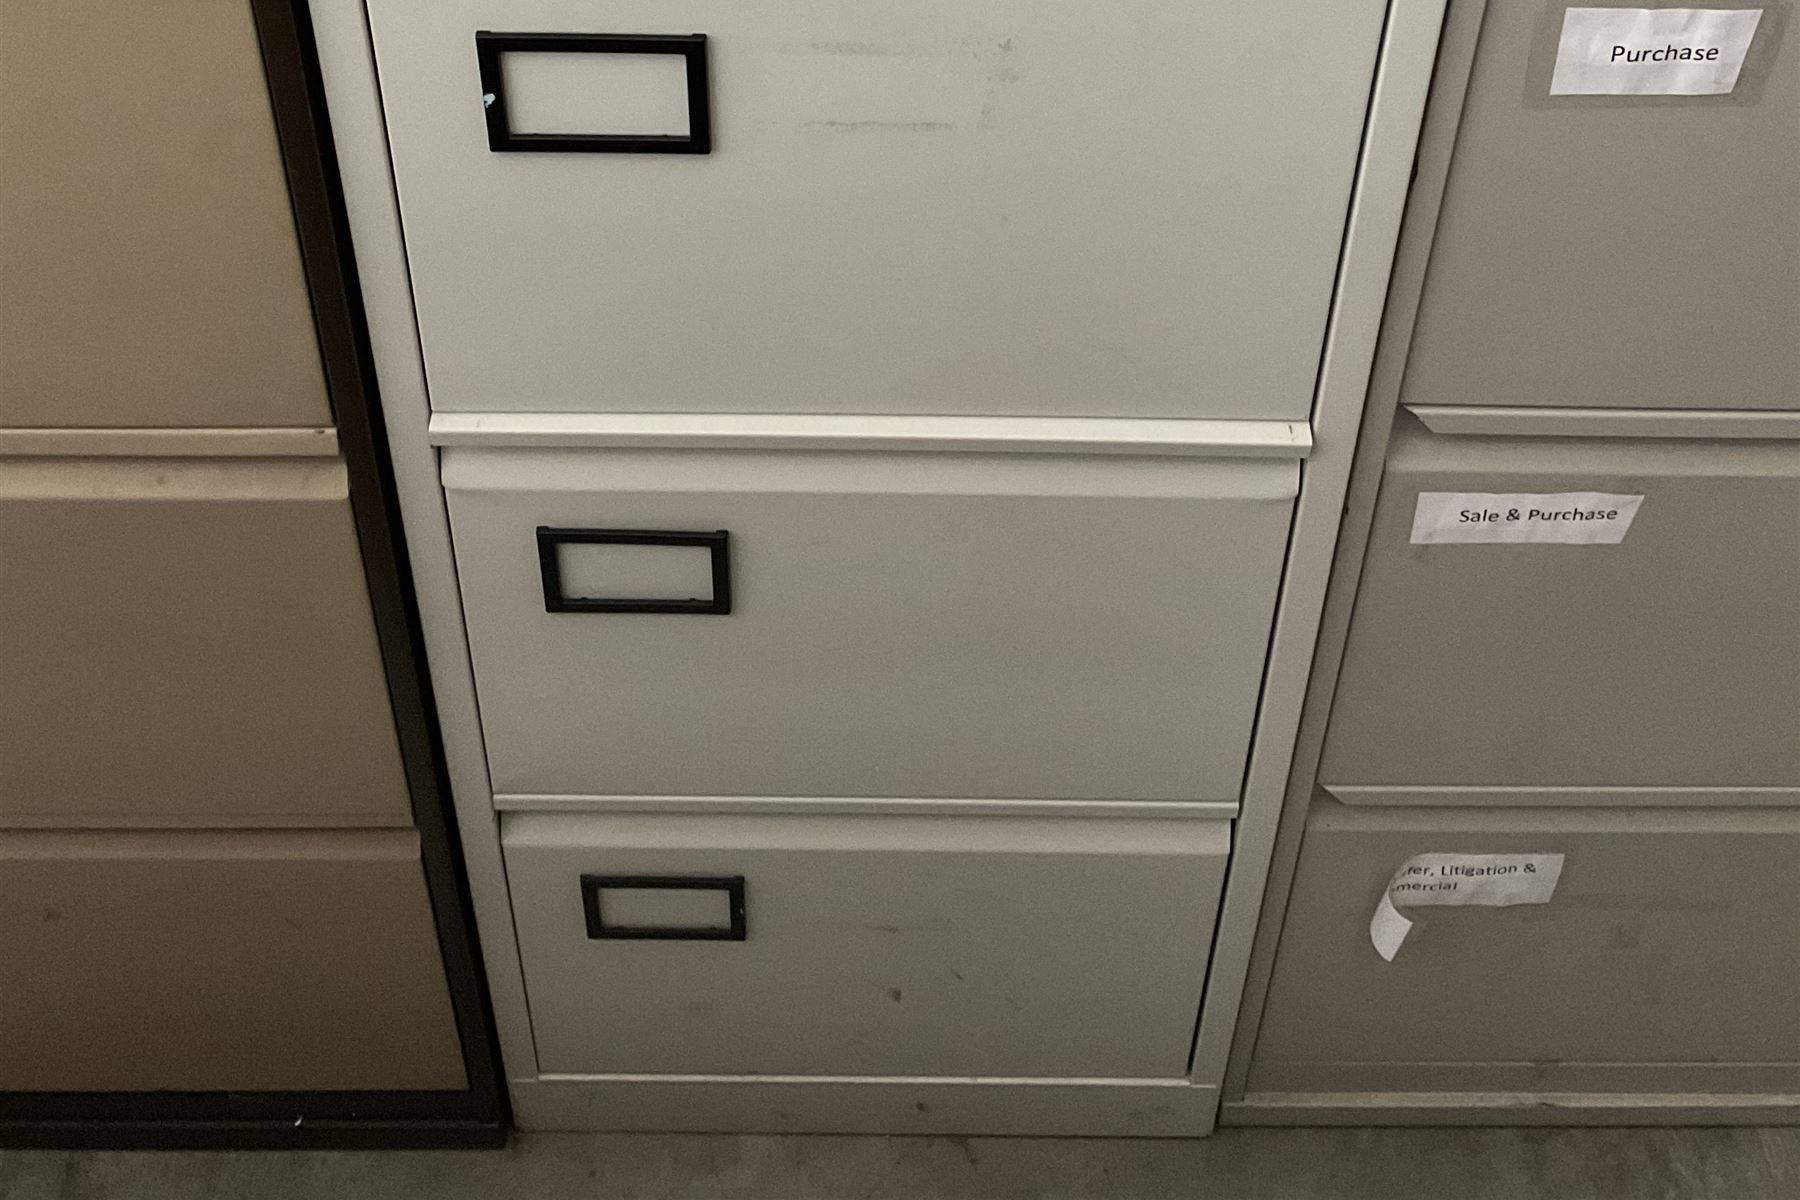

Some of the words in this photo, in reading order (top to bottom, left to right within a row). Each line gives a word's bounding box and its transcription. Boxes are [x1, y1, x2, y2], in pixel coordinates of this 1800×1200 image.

[1610, 44, 1719, 62] Purchase
[1459, 509, 1499, 523] Sale
[1506, 508, 1520, 521] &
[1528, 507, 1619, 522] Purchase
[1441, 863, 1518, 877] Litigation
[1523, 863, 1537, 873] &
[1392, 882, 1458, 892] mercial
